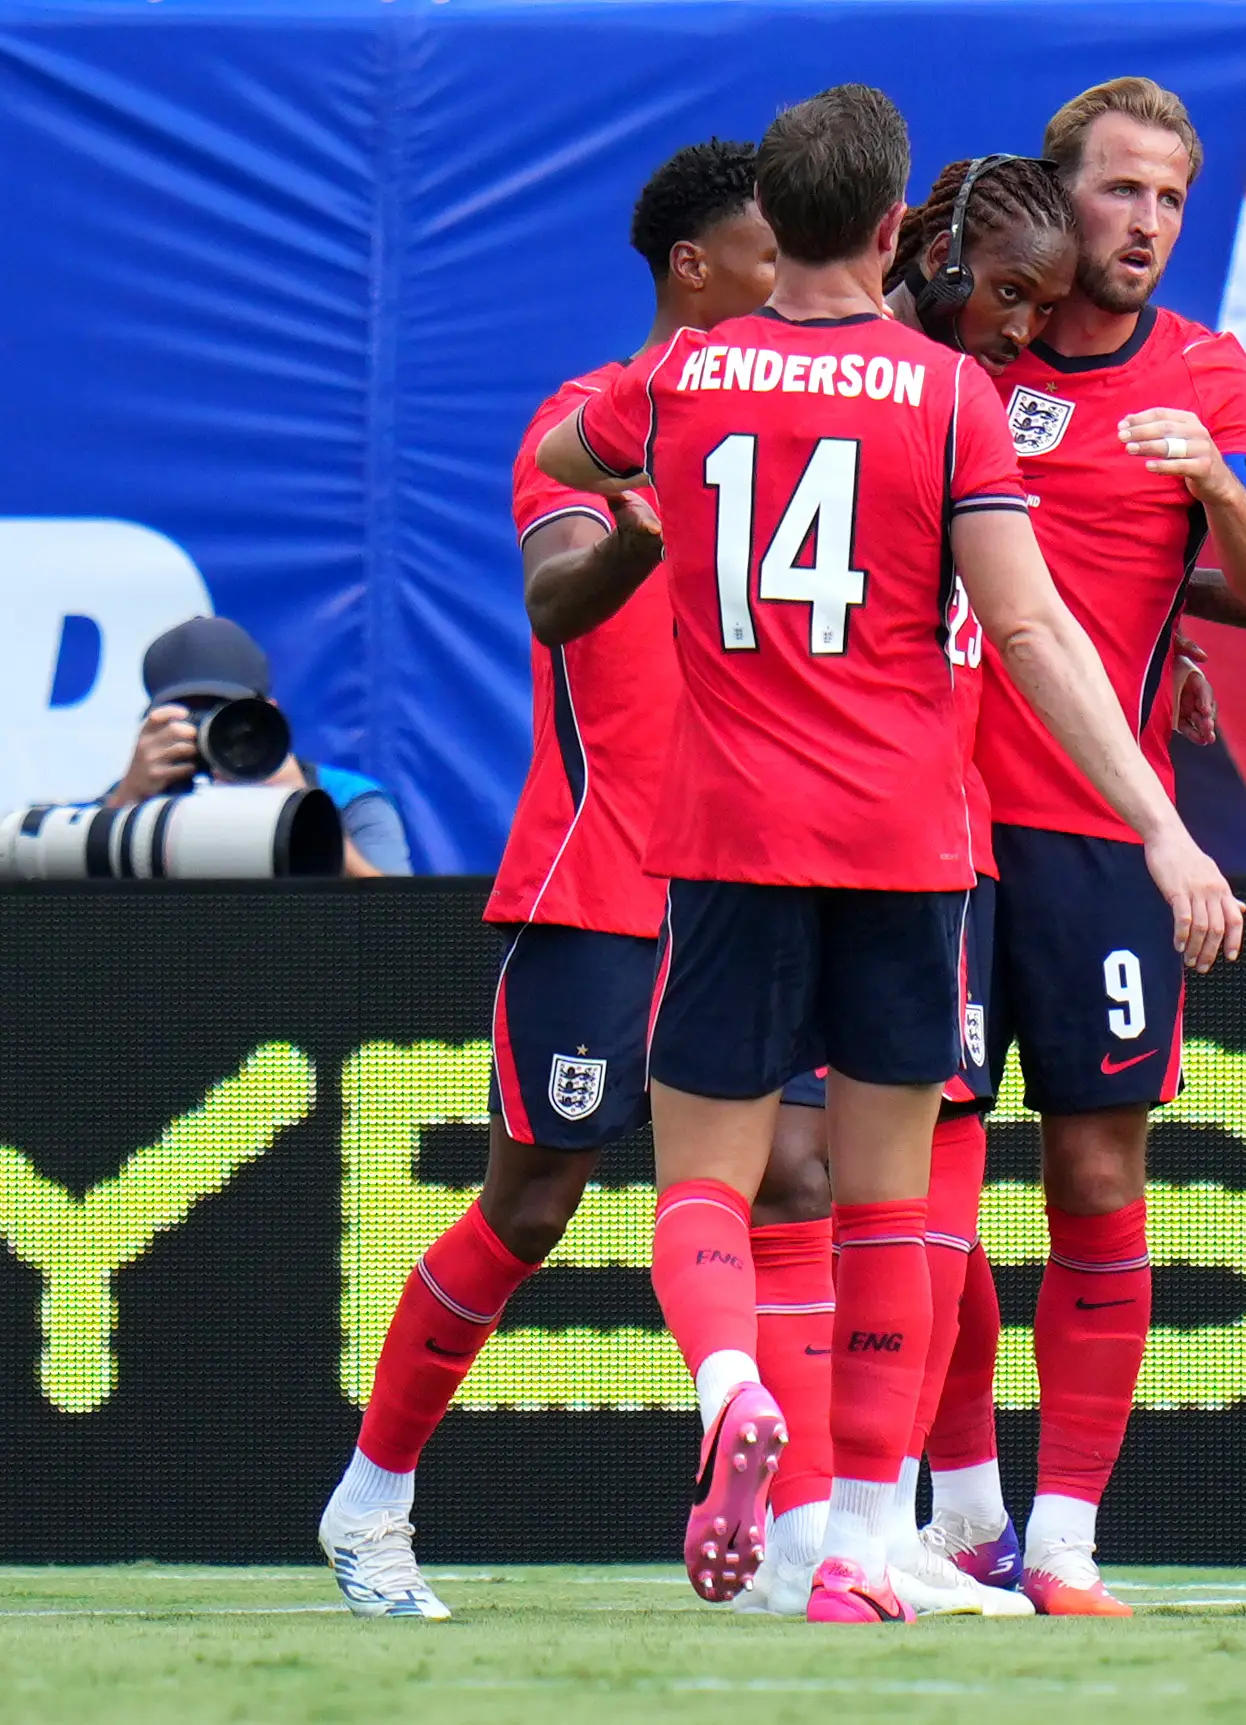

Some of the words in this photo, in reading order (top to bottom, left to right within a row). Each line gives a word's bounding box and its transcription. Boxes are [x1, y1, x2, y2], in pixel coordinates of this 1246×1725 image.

[677, 346, 925, 407] HENDERSON
[704, 433, 867, 655] 14
[1103, 949, 1146, 1040] 9
[696, 1249, 744, 1272] ENG
[848, 1330, 904, 1353] ENG
